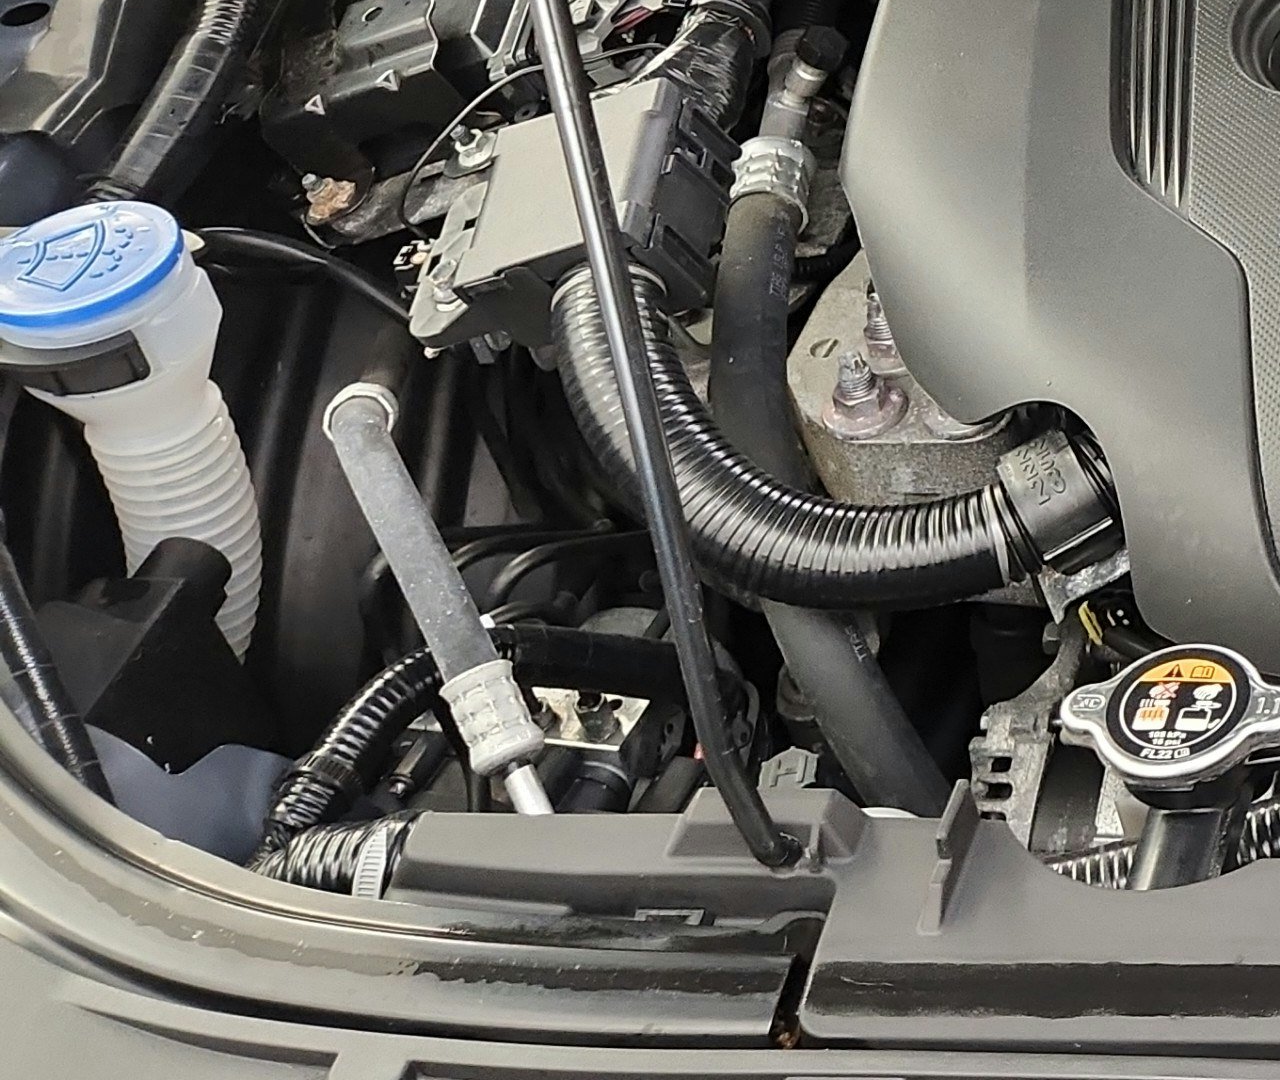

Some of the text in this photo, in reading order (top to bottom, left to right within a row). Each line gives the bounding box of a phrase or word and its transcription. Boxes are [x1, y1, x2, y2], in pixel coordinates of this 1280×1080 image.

[1166, 730, 1187, 739] kPa
[1164, 738, 1182, 747] psi
[1139, 748, 1173, 759] FL22
